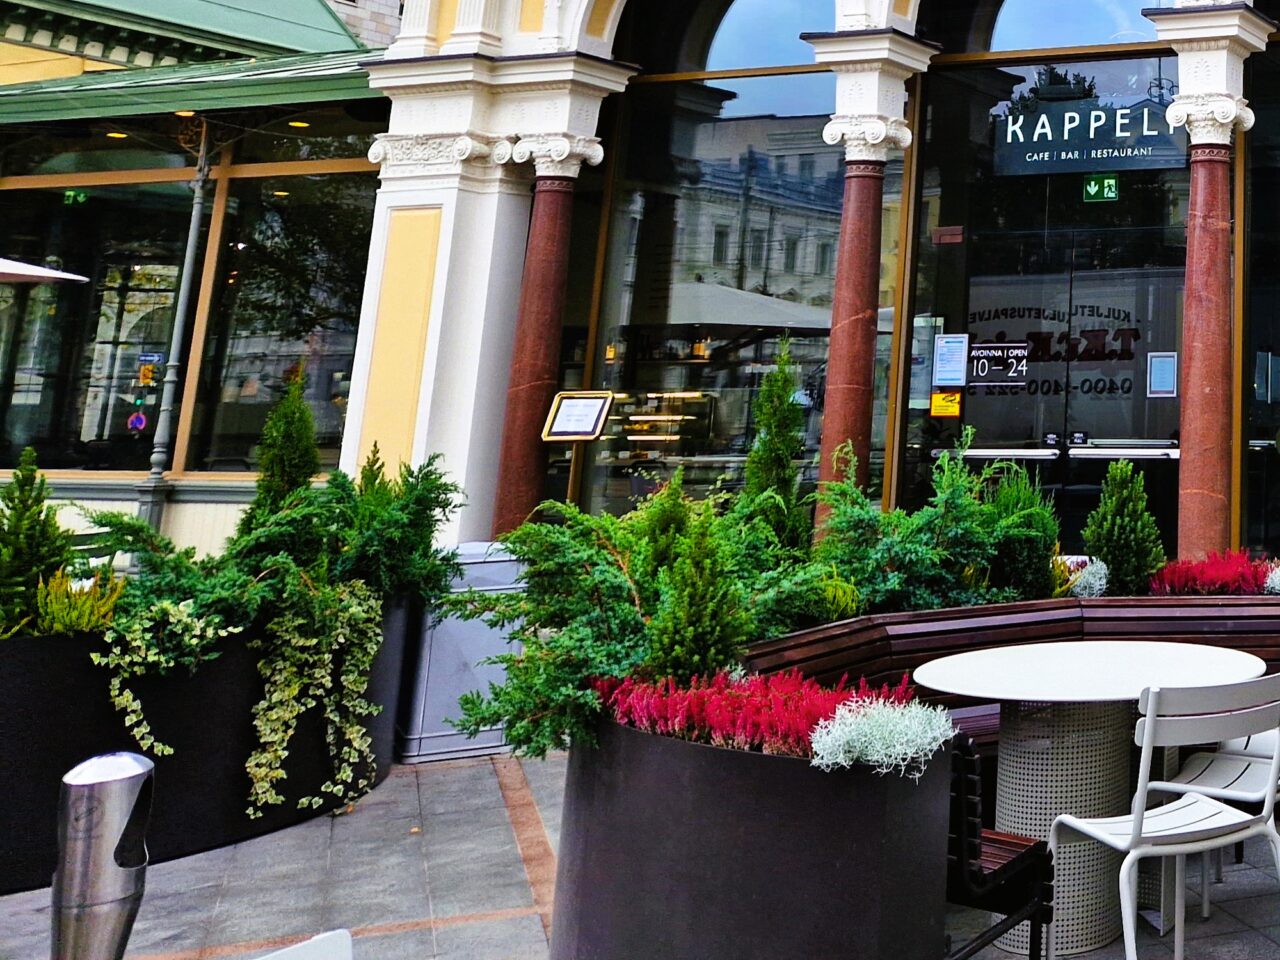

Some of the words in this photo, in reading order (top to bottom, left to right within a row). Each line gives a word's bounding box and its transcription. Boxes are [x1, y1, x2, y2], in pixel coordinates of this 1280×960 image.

[1025, 151, 1050, 162] CAFE
[1060, 150, 1080, 160] BAR
[1091, 147, 1153, 159] RESTAURANT
[970, 349, 1003, 357] AVOINNA
[1008, 348, 1028, 357] OPEN
